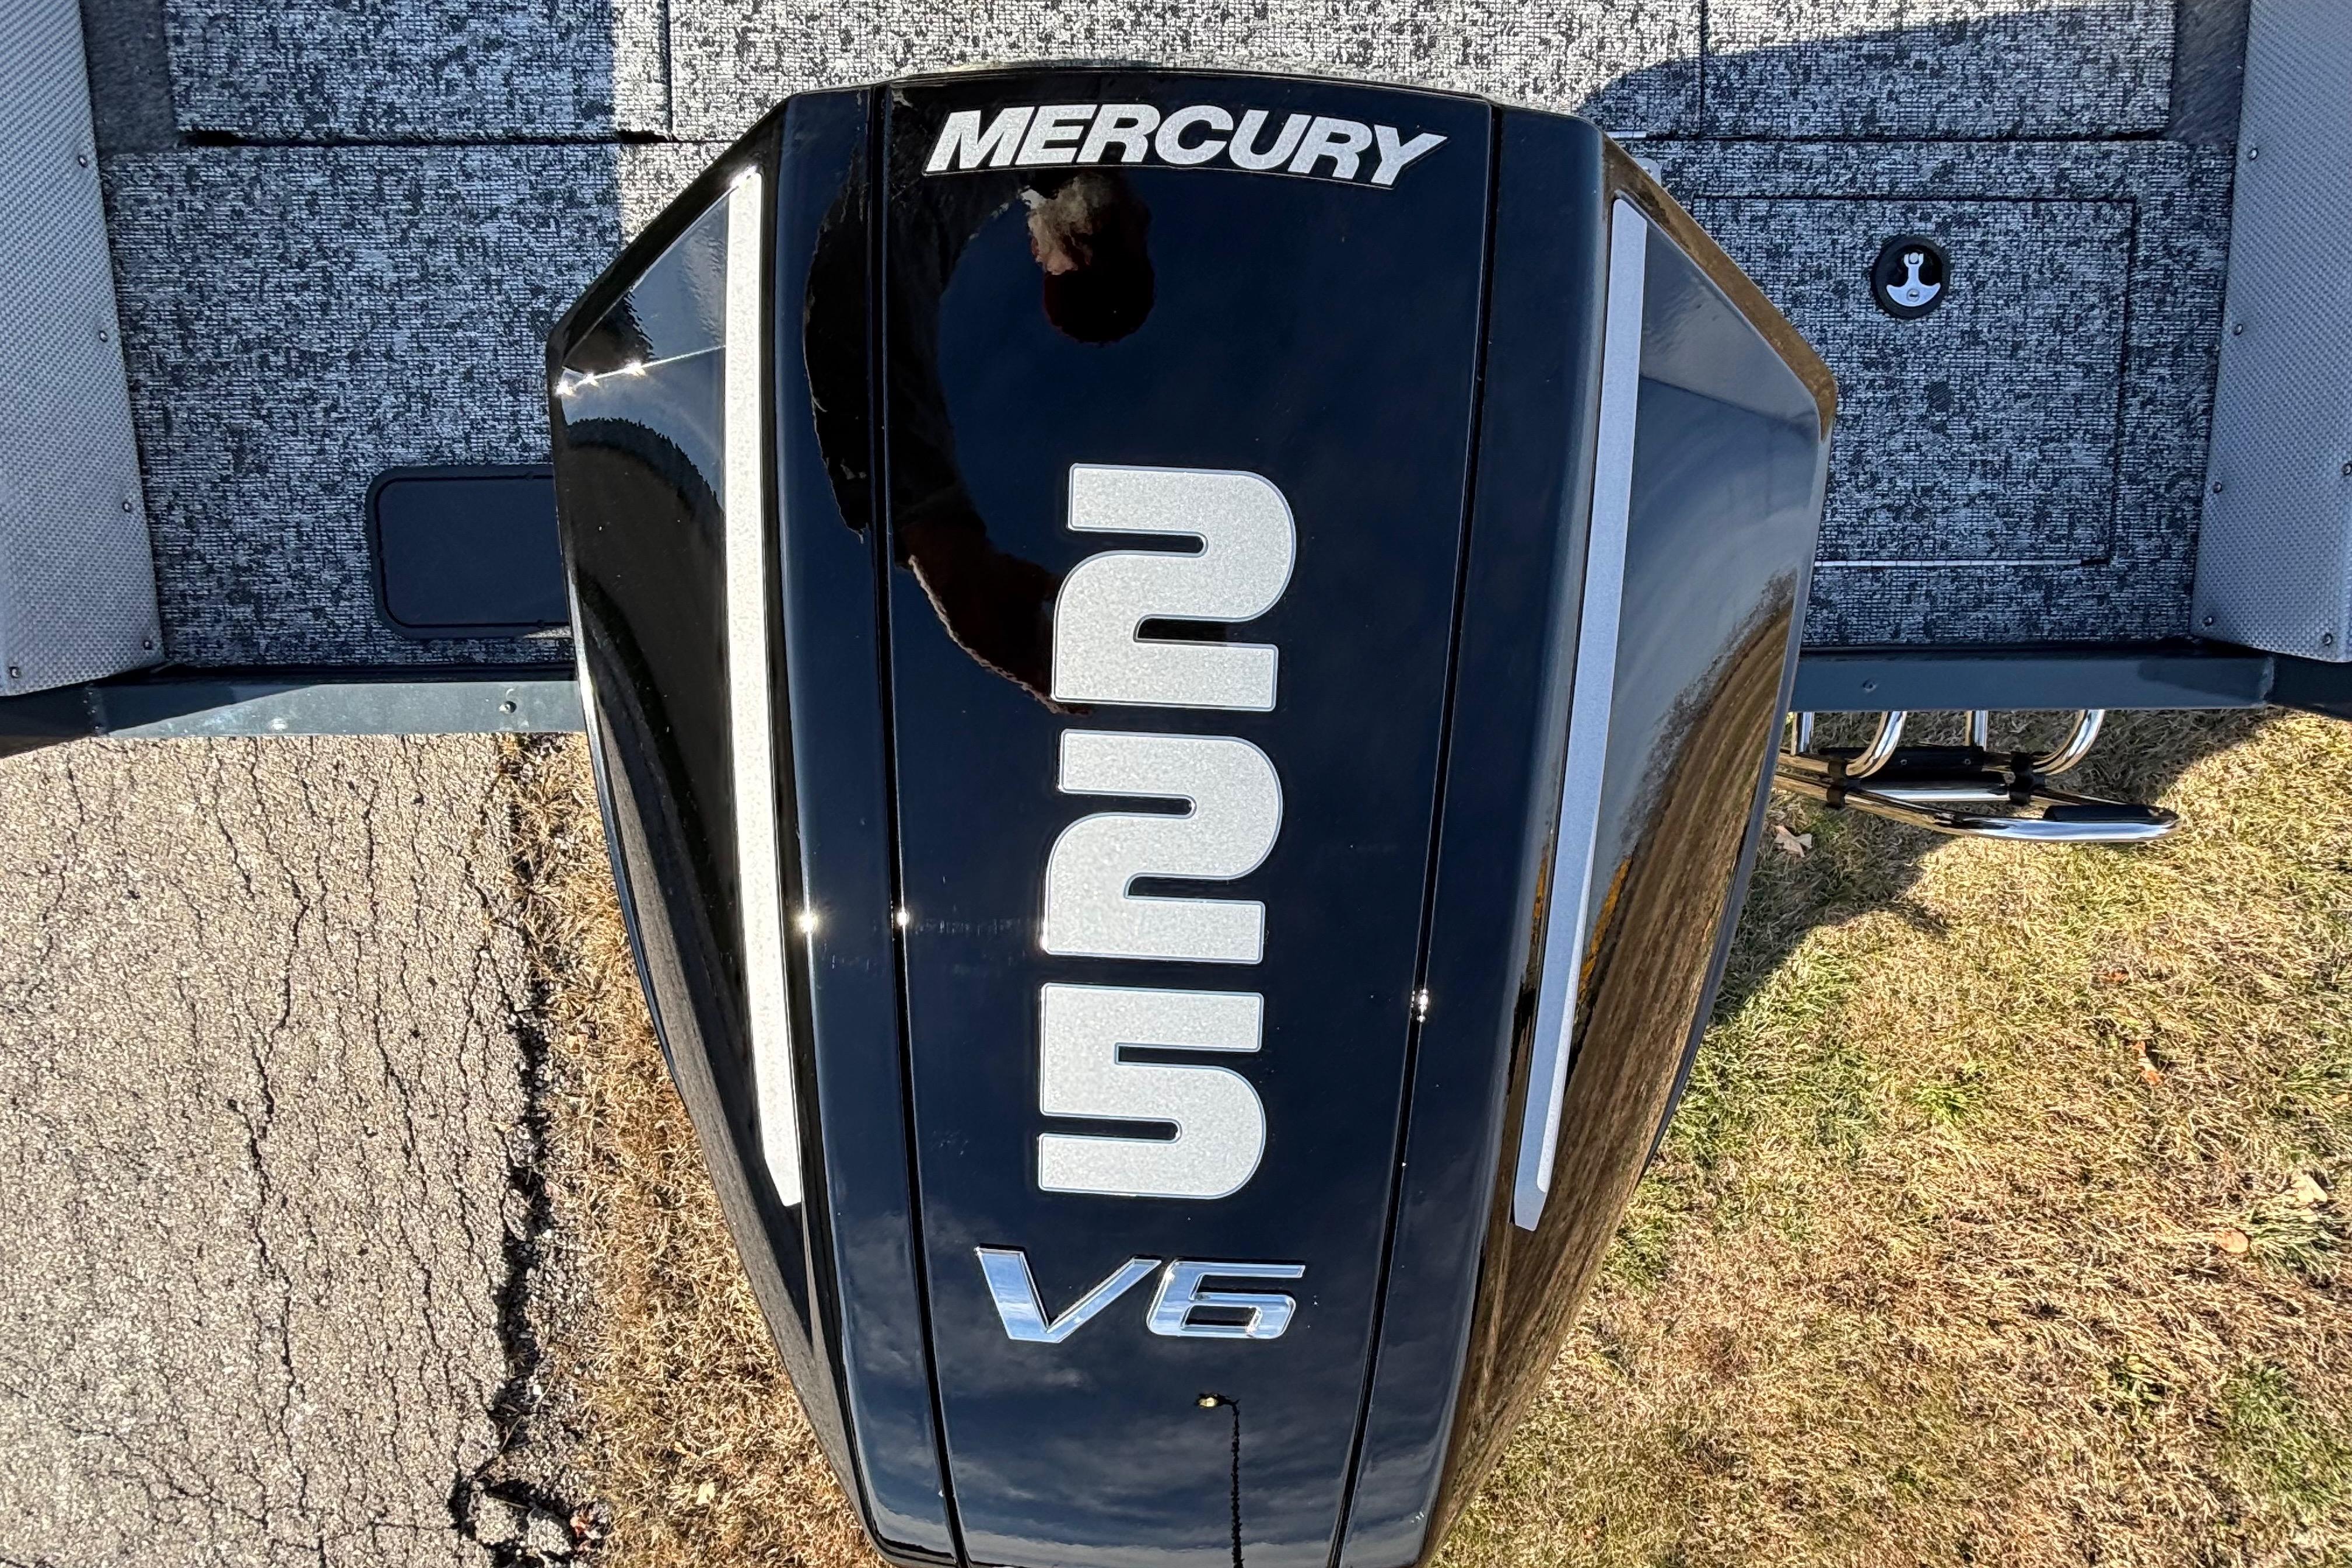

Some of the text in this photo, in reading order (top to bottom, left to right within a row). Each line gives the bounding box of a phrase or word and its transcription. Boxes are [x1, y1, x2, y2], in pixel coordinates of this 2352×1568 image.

[926, 103, 1448, 187] MERCURY
[1038, 463, 1297, 1200] 225
[975, 1245, 1306, 1343] V6
